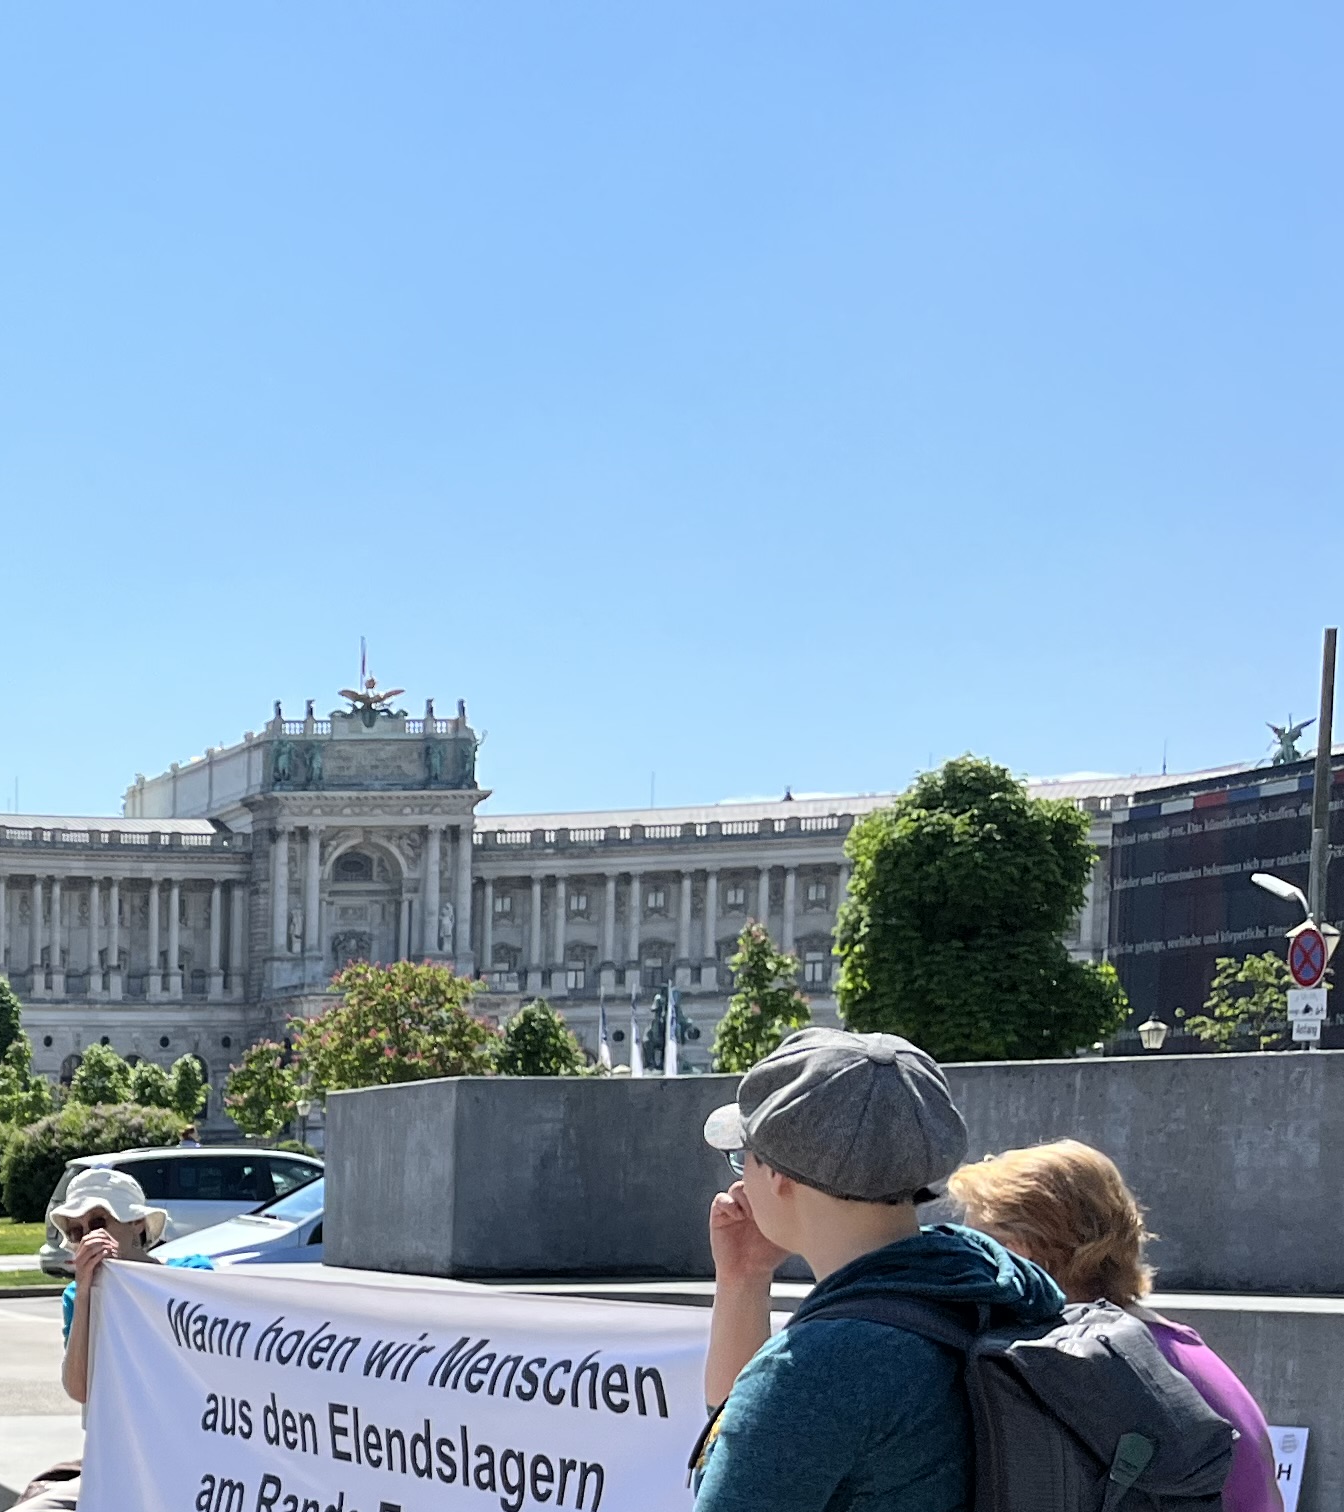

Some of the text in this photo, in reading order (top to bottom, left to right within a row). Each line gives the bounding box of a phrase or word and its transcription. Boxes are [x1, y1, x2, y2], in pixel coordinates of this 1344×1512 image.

[167, 1298, 669, 1418] Wann holen wir Menschen
[201, 1391, 253, 1441] aus
[263, 1393, 318, 1456] den
